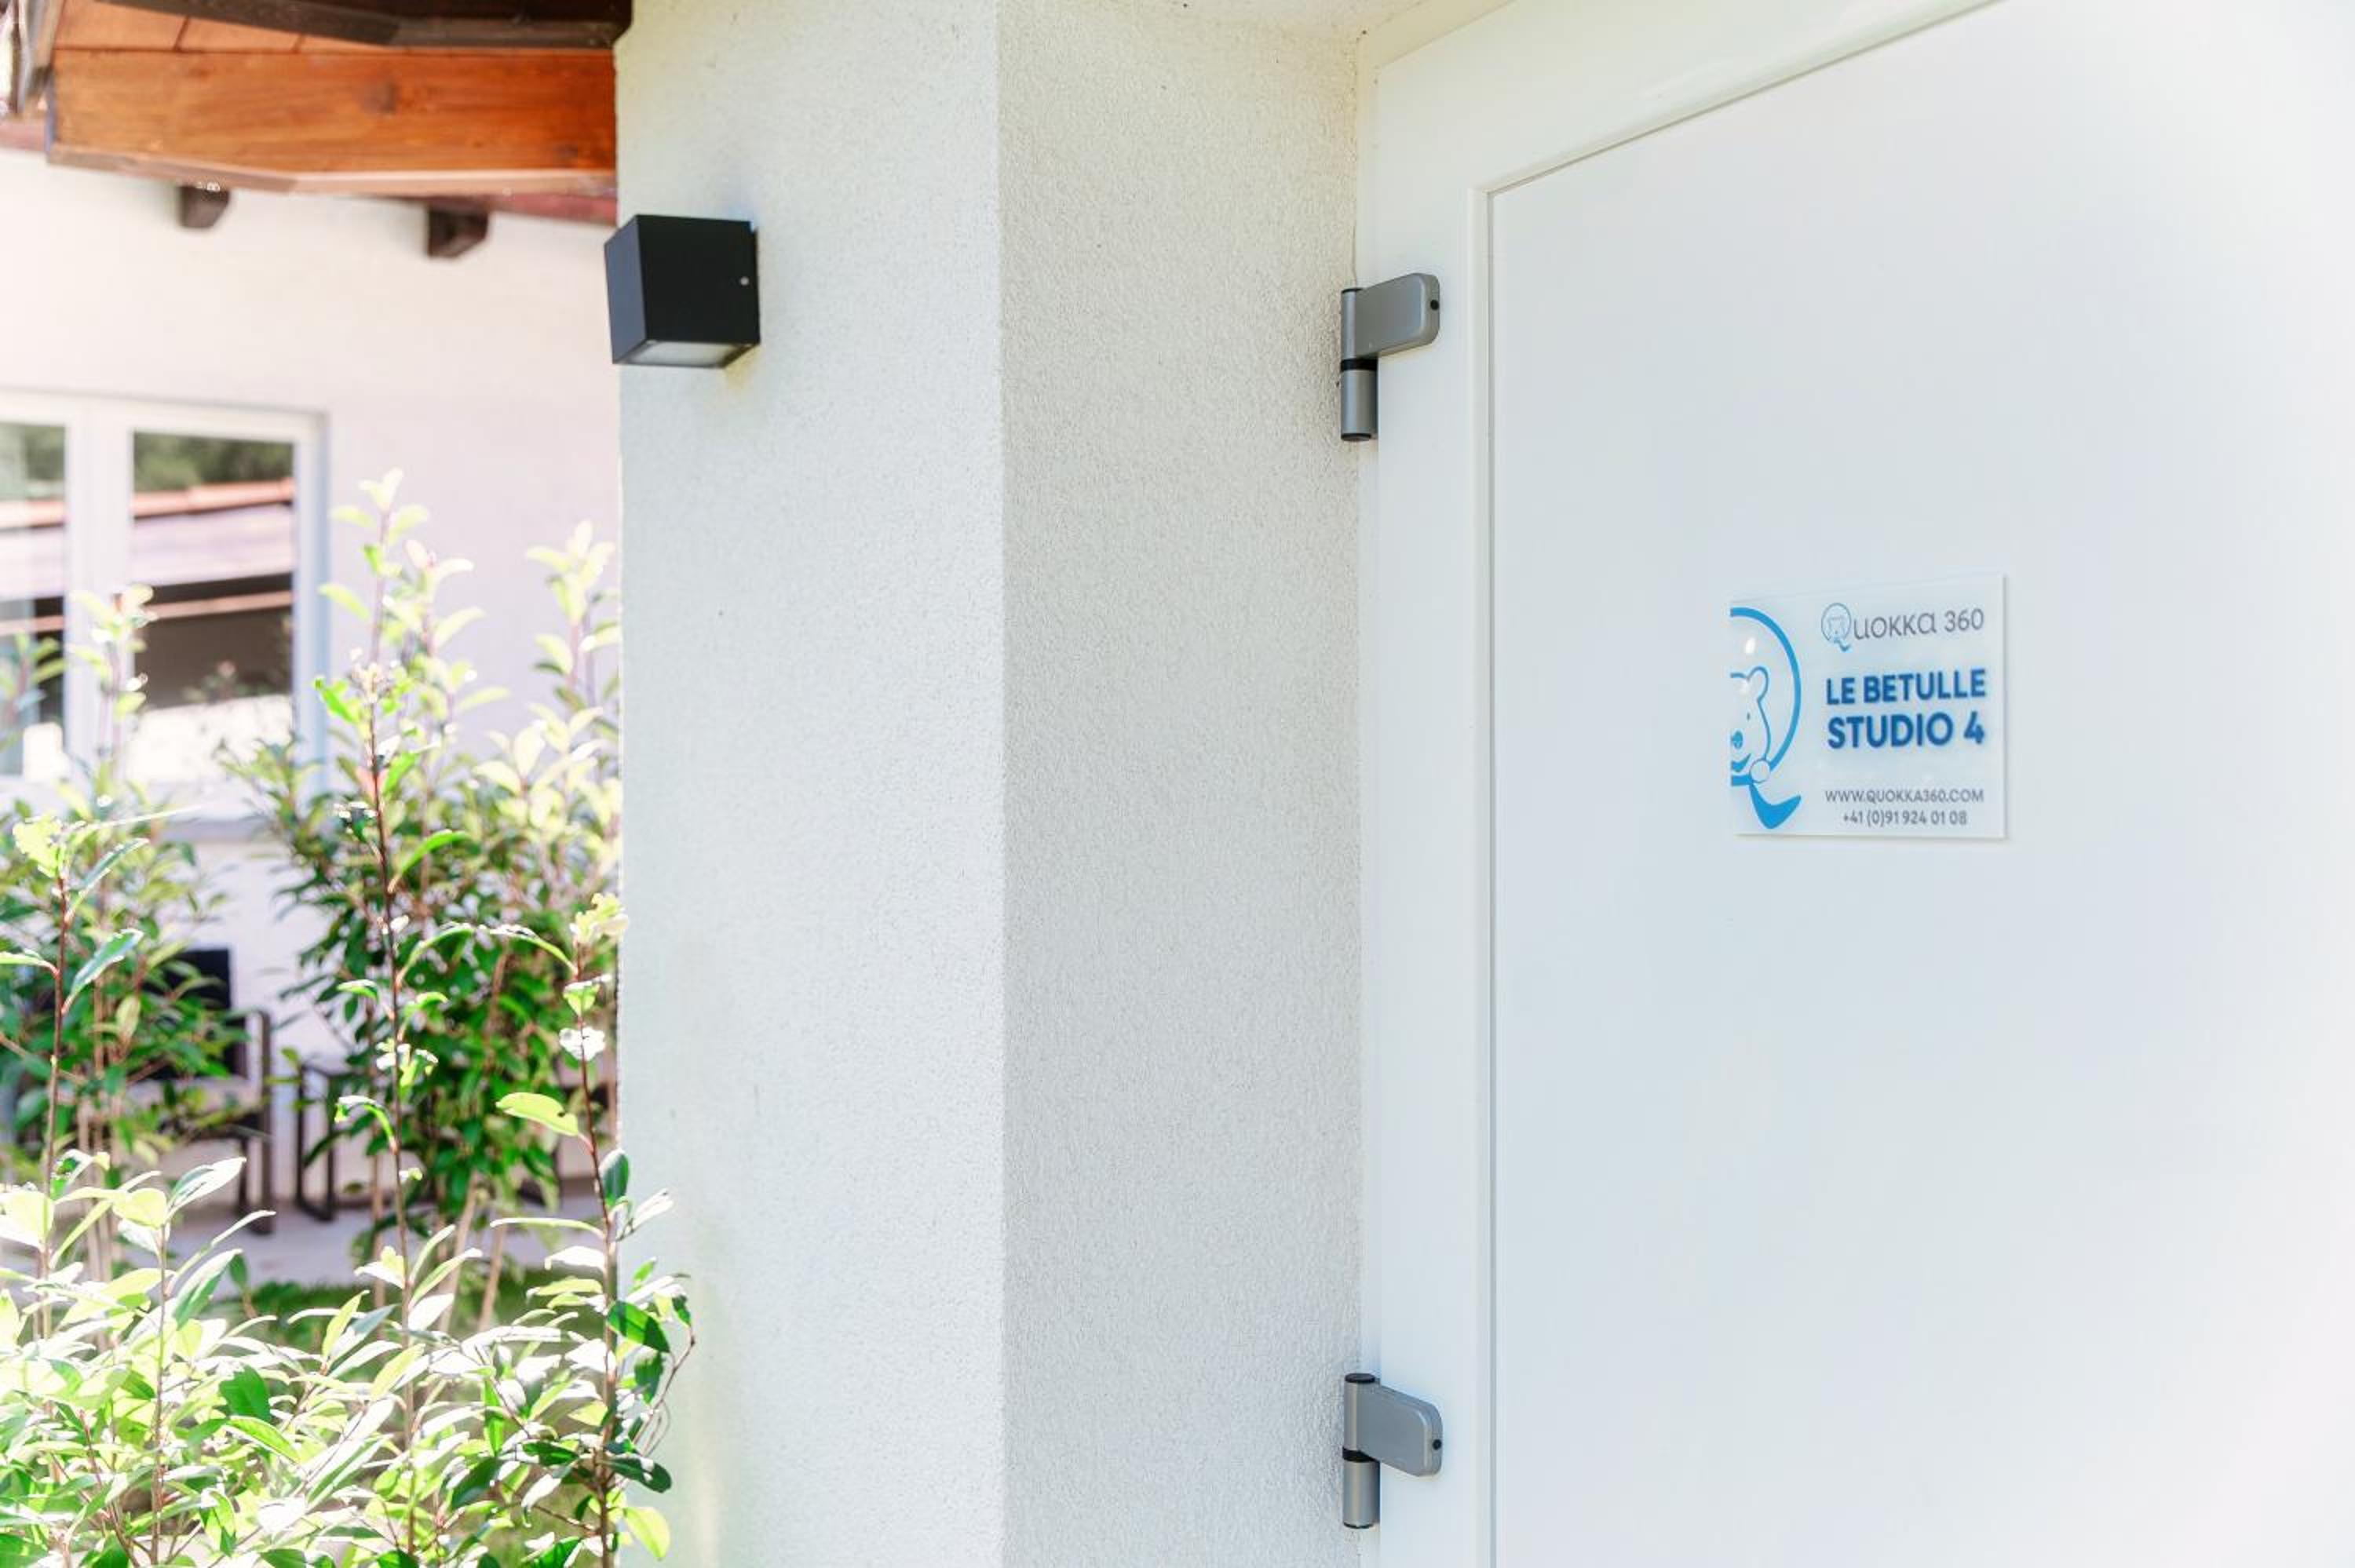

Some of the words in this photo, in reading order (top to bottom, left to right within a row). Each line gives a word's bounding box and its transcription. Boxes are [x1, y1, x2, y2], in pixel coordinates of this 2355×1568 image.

[1944, 608, 1984, 633] 360
[1826, 677, 1855, 705] LE
[1864, 669, 1985, 703] BETULLE
[1827, 713, 1953, 749] STUDIO
[1964, 712, 1984, 744] 4
[1825, 789, 1984, 804] WWW.QUOKKA360.COM
[1843, 811, 1862, 825] +41
[1903, 811, 1926, 825] 924
[1931, 811, 1947, 825] 01
[1950, 811, 1967, 825] 08
